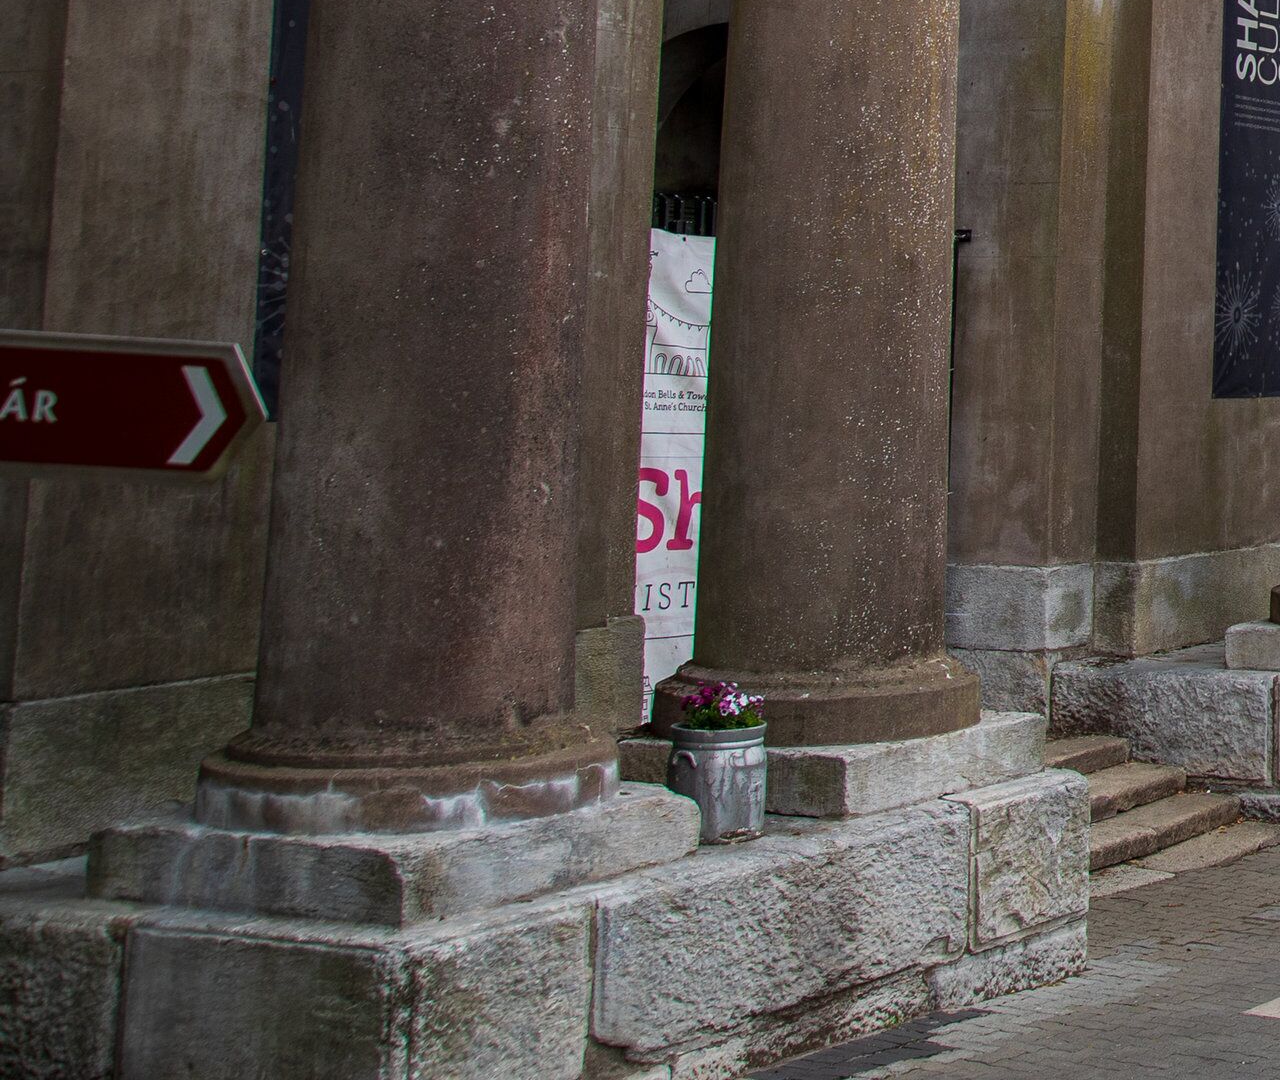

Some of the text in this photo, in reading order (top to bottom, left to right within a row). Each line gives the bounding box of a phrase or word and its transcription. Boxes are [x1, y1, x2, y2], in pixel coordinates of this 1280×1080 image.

[0, 376, 59, 423] ÁR
[658, 390, 676, 400] Bells
[678, 391, 685, 400] &
[653, 402, 677, 412] Anne's
